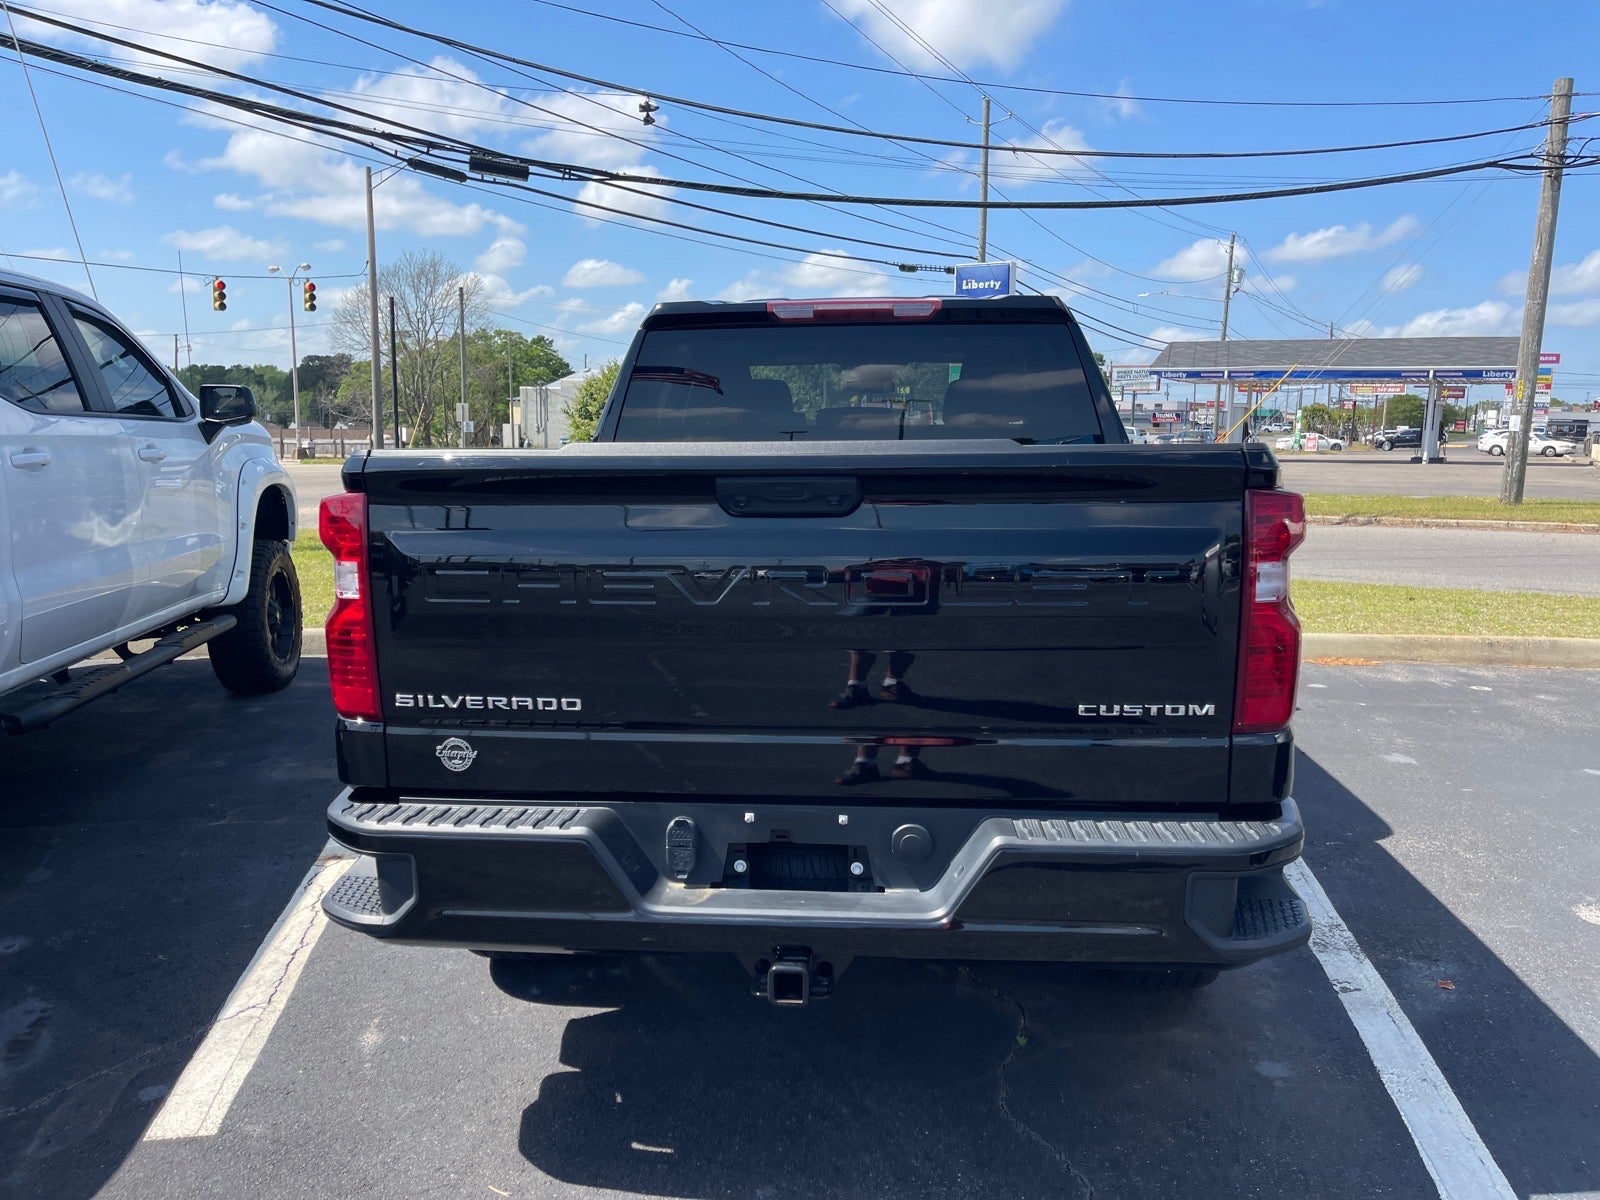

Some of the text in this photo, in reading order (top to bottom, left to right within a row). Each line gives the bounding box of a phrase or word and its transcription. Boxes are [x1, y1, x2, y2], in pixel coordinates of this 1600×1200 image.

[962, 279, 1002, 290] Liberty
[1161, 371, 1187, 379] Liberty
[1482, 371, 1514, 379] Liberty
[395, 694, 582, 711] SILVERADO
[1078, 704, 1216, 716] CUSTOM
